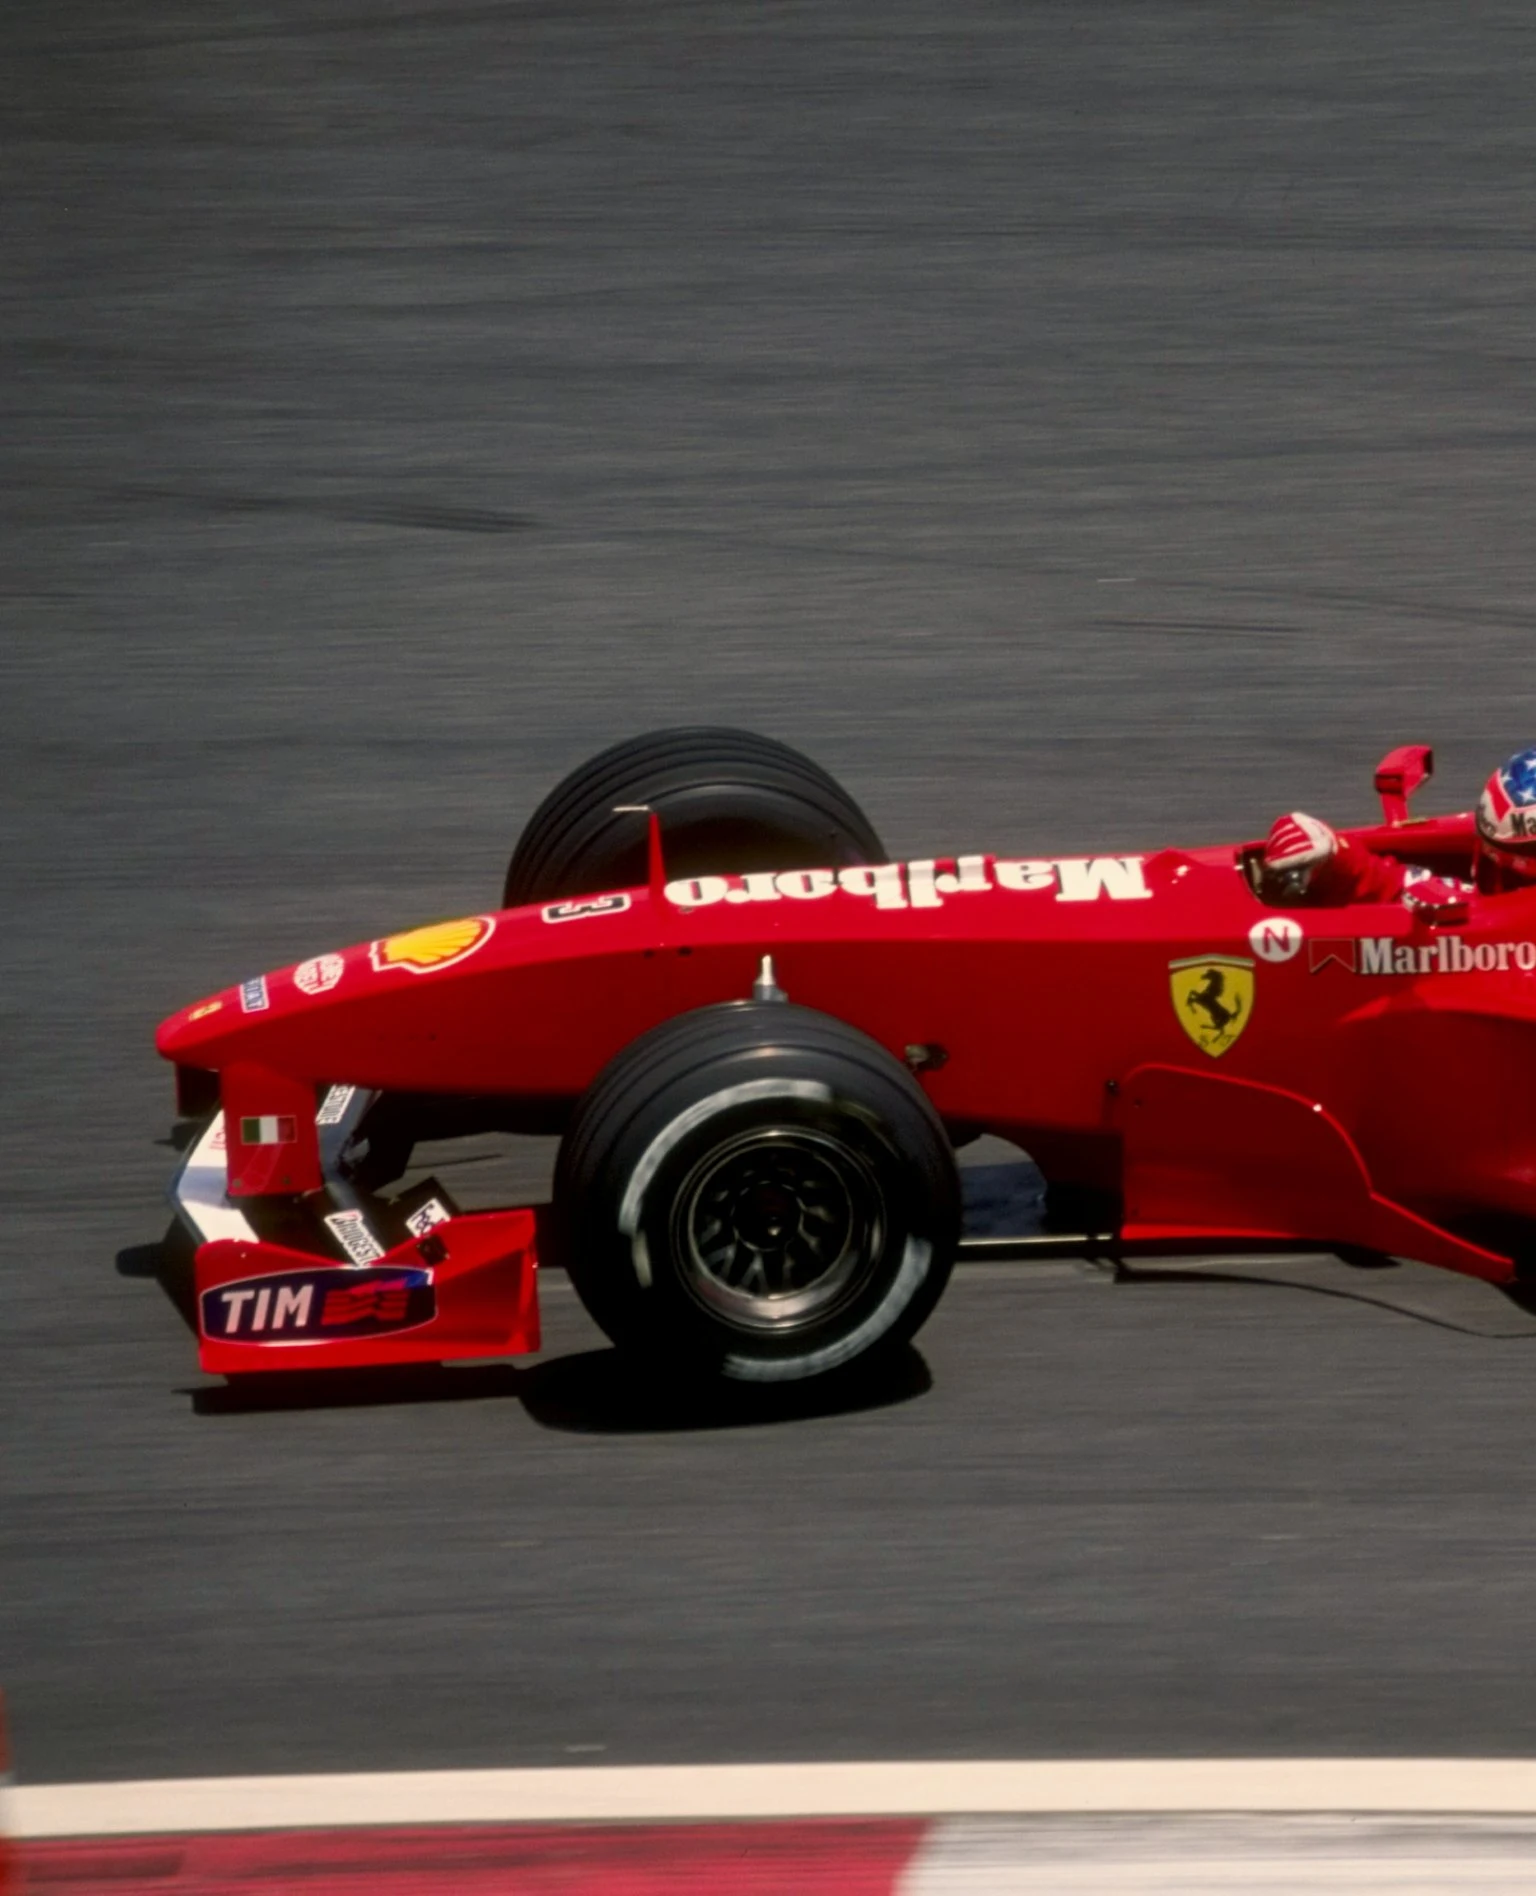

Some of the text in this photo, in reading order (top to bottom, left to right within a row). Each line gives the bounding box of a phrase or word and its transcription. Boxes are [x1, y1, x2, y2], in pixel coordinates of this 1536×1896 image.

[664, 856, 1153, 909] Marlboro
[545, 895, 626, 921] 3
[1262, 924, 1291, 953] N
[221, 1284, 316, 1335] TIM
